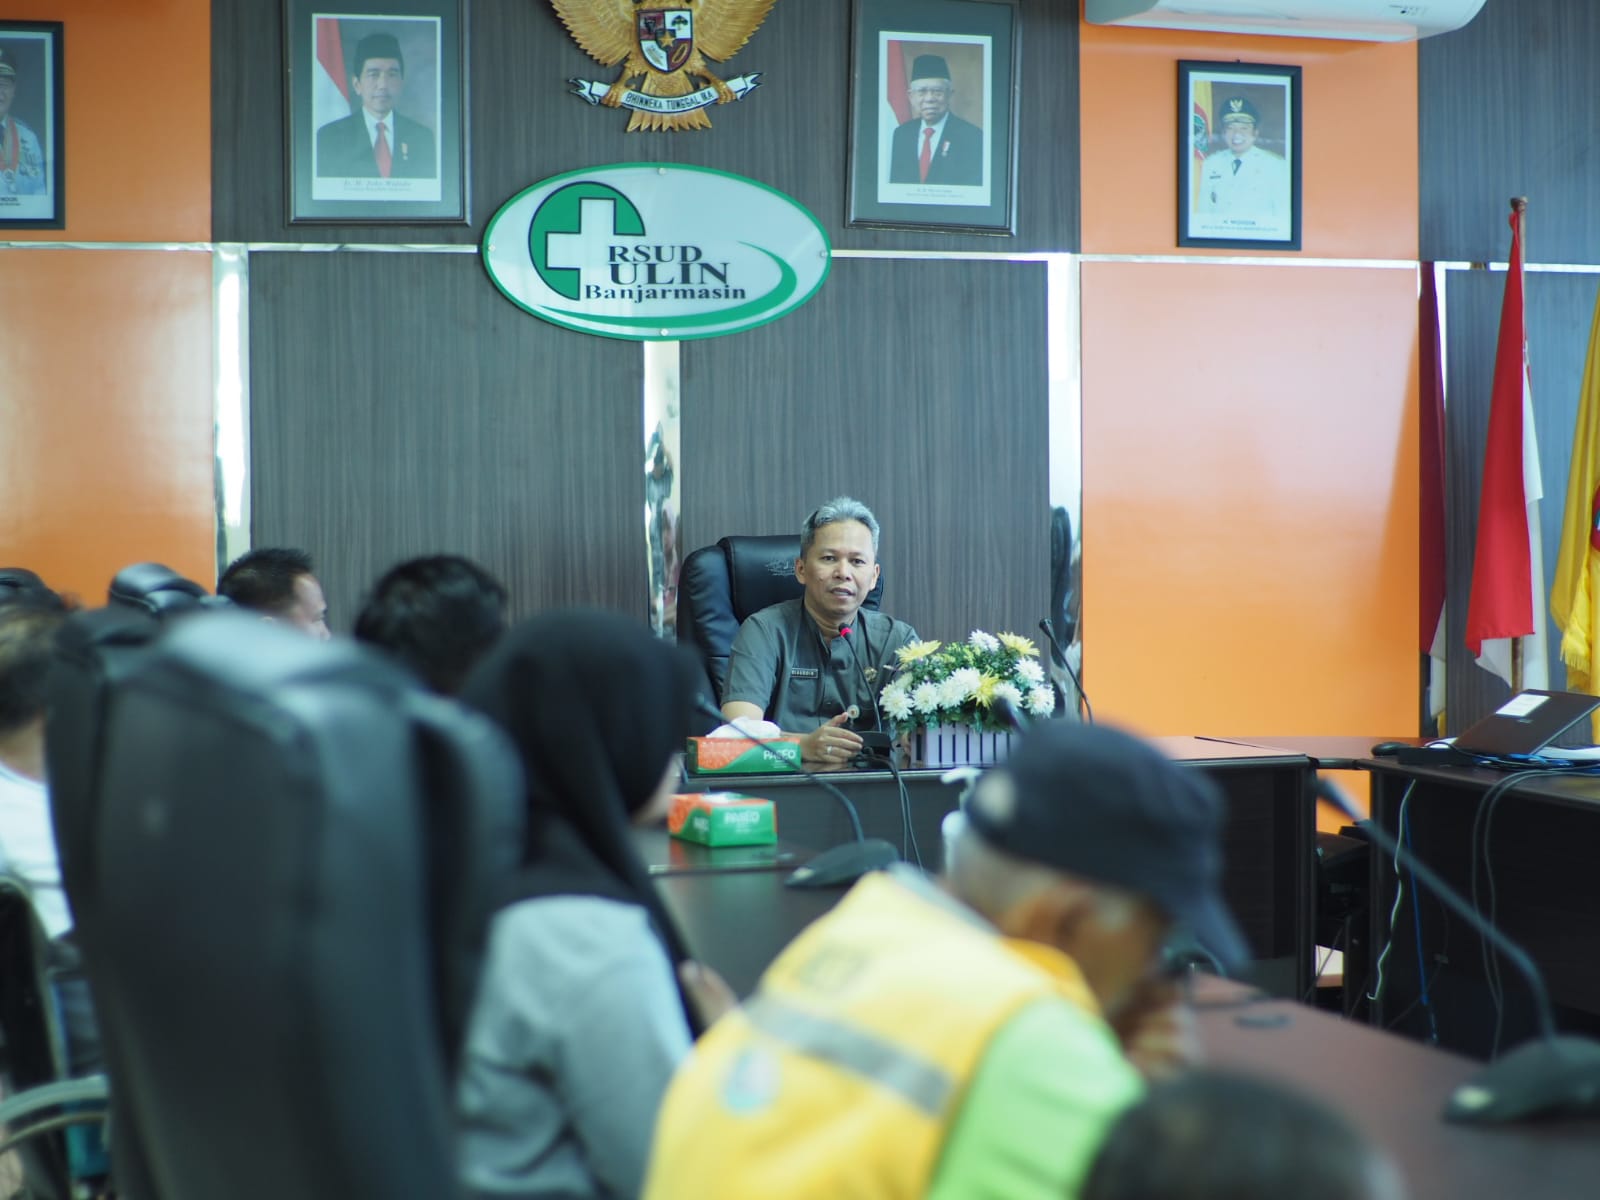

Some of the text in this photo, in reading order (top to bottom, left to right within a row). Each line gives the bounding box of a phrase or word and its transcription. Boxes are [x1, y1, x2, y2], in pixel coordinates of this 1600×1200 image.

[626, 90, 714, 110] BHINNEKA TUNGGAL IKA
[608, 245, 703, 263] RSUD
[609, 262, 731, 286] ULIN
[585, 284, 747, 304] Banjarmasin
